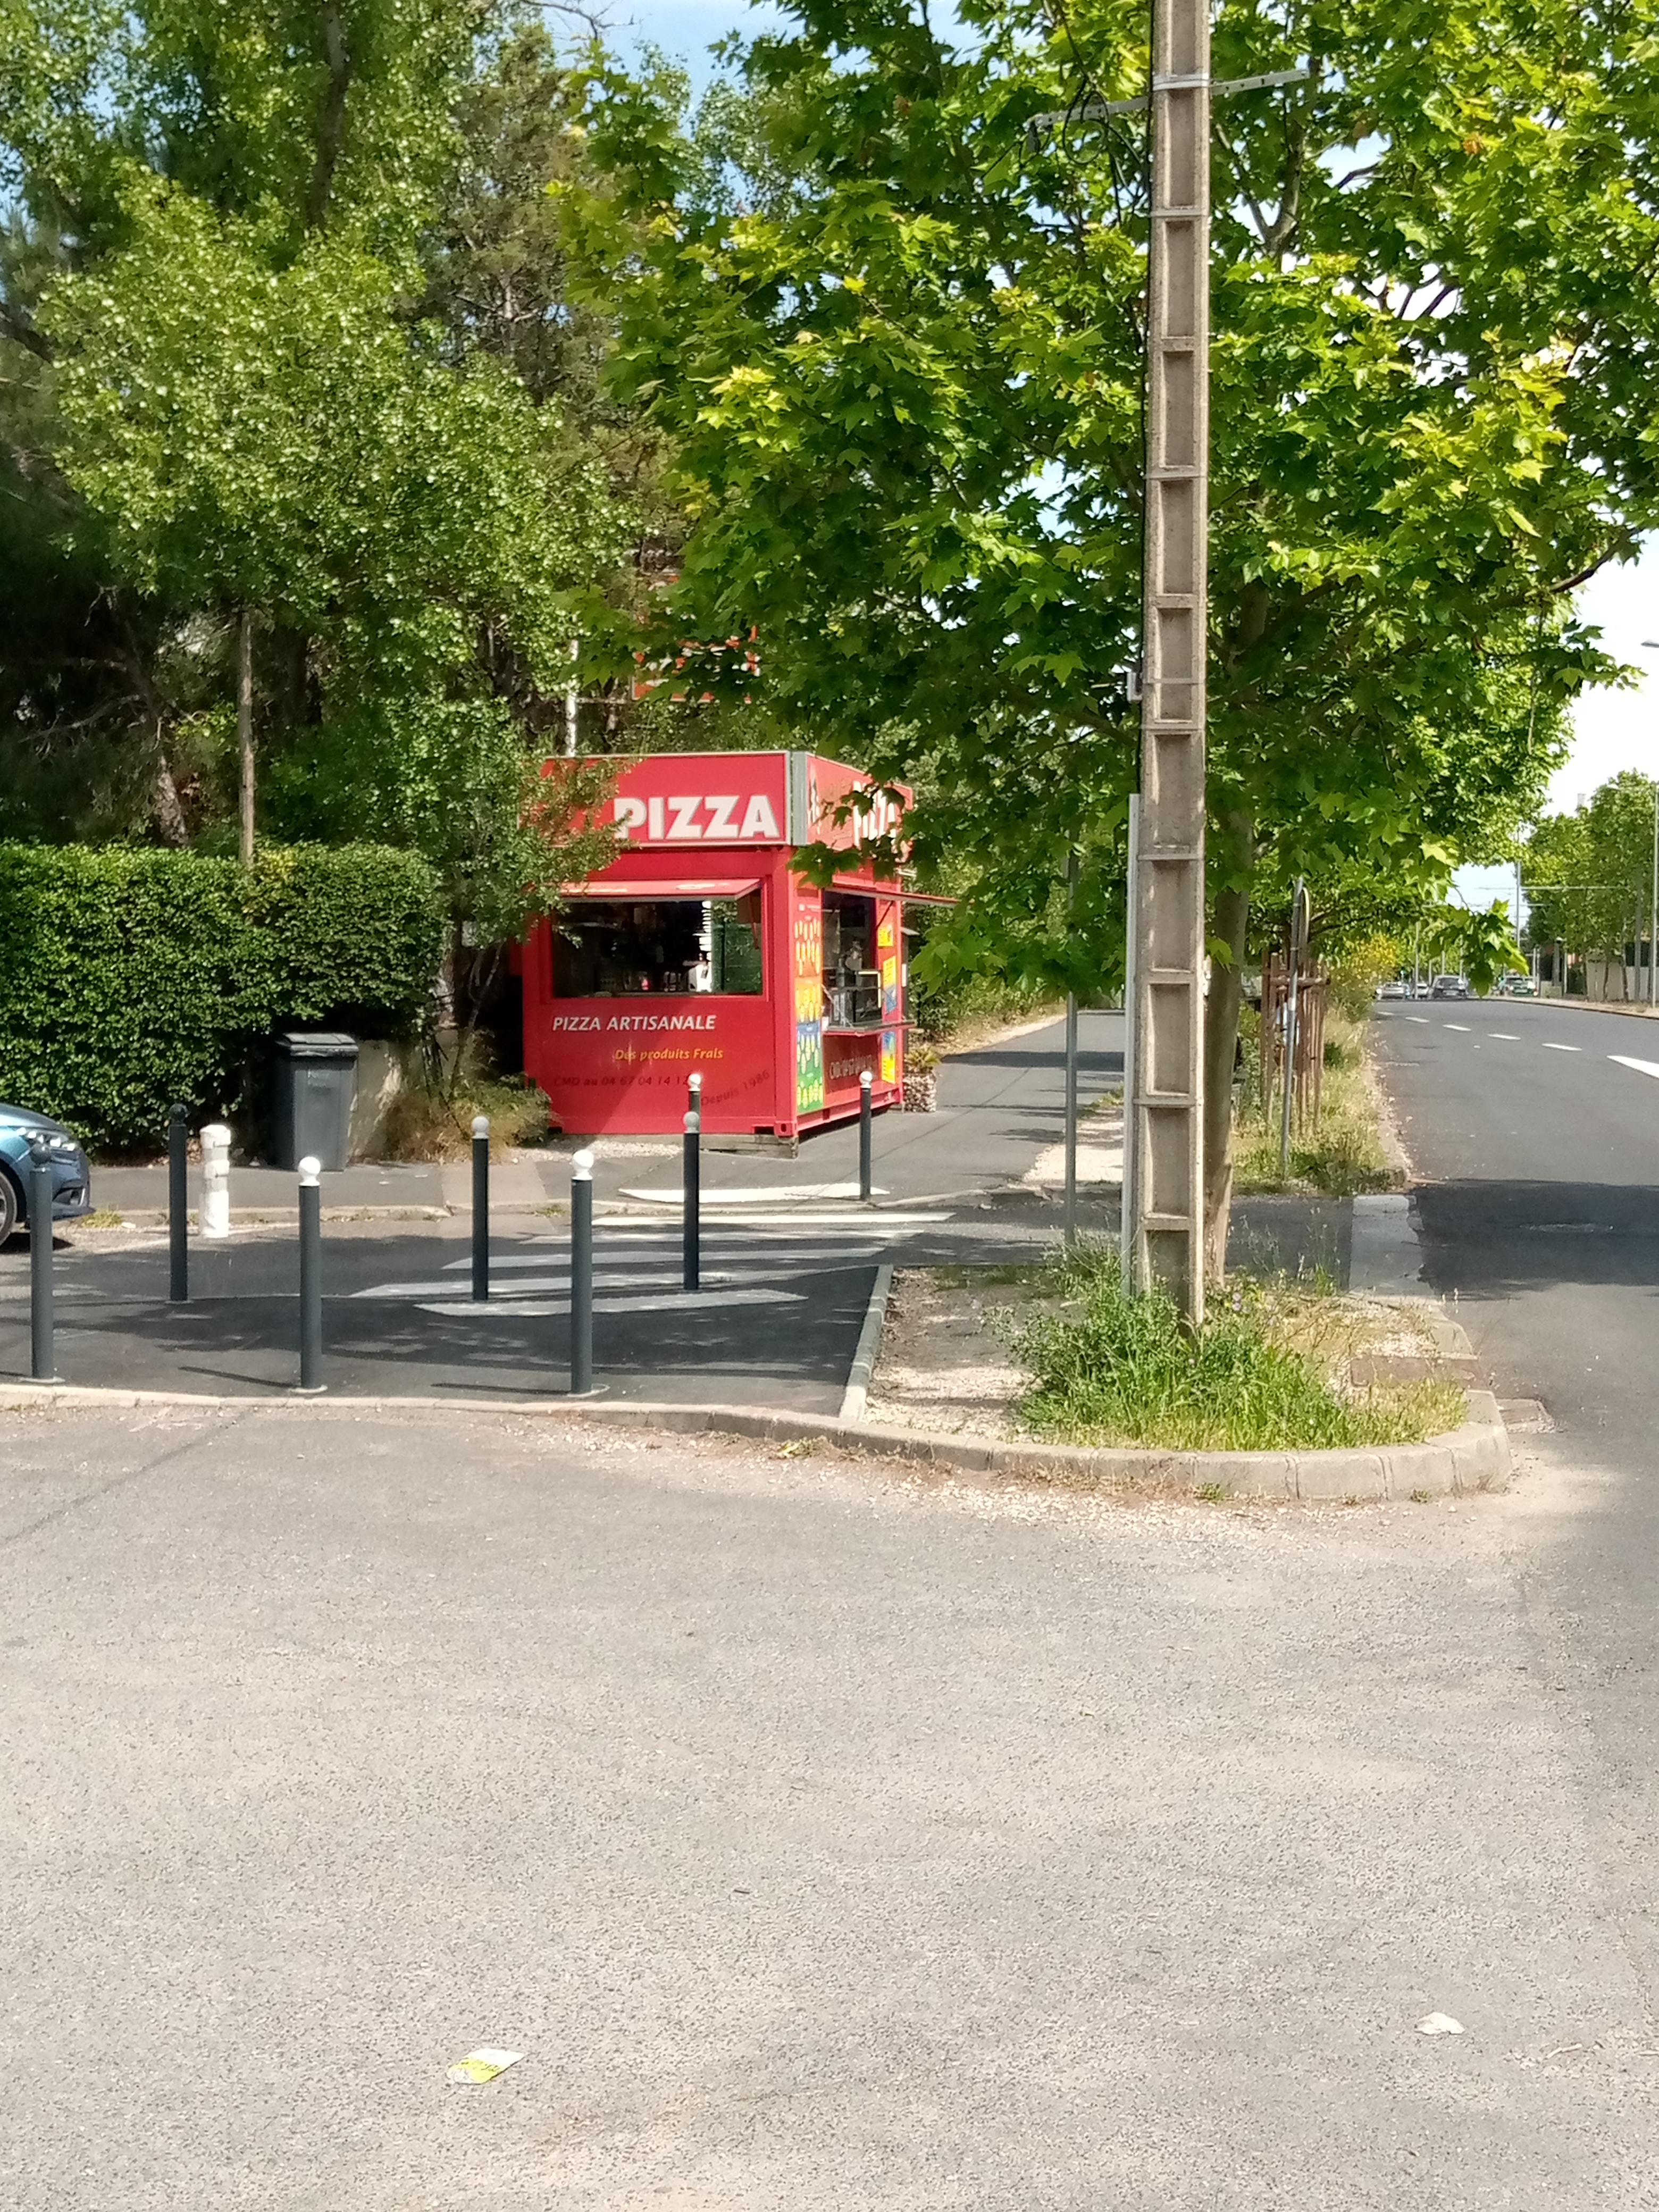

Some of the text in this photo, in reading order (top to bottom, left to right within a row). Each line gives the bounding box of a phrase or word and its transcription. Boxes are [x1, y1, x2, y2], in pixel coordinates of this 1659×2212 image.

[614, 795, 780, 840] PIZZA
[552, 1015, 716, 1031] PIZZA ARTISANALE
[615, 1048, 724, 1061] Des produits Frais
[554, 1076, 580, 1086] CMD
[638, 1075, 652, 1085] 04
[658, 1075, 670, 1085] 14
[700, 1069, 770, 1106] Depuis 1986
